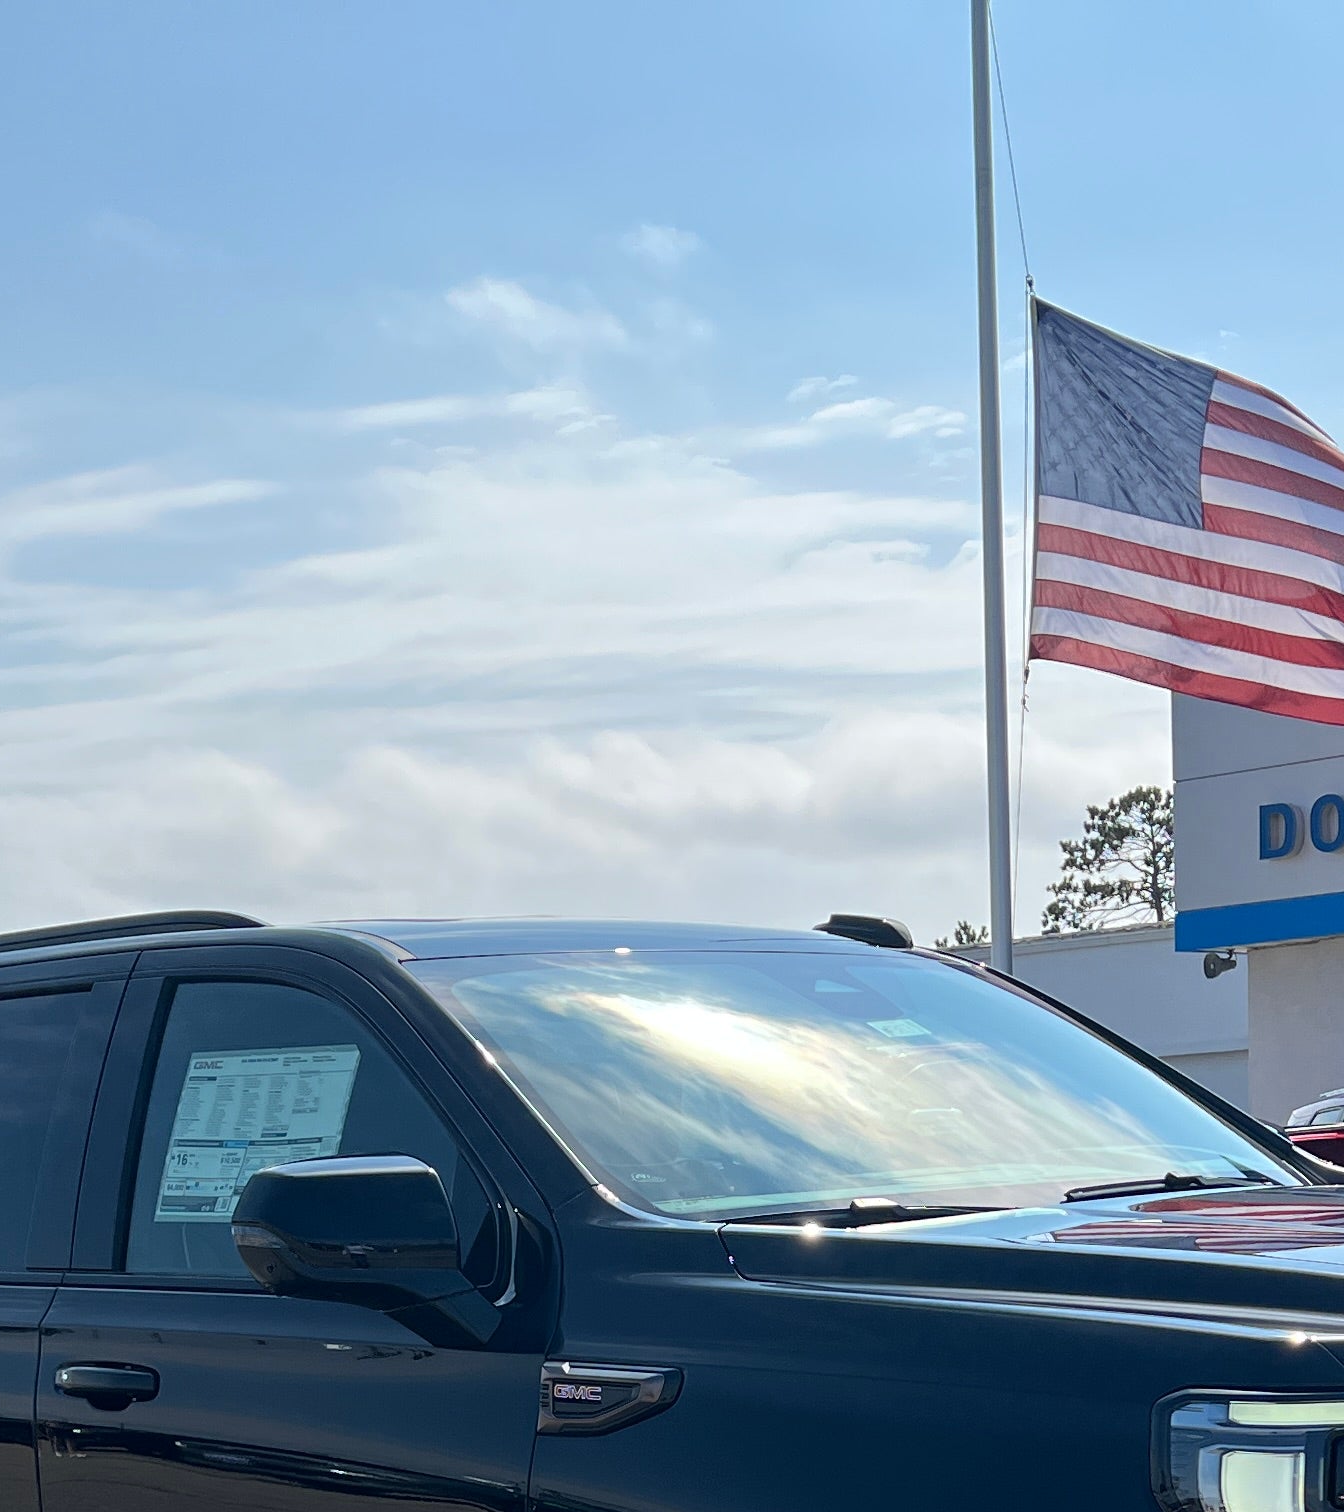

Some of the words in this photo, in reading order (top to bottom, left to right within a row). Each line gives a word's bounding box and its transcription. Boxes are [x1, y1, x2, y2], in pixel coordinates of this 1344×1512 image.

[193, 1060, 224, 1070] GMC
[176, 1153, 188, 1166] 16
[554, 1384, 602, 1400] GMC
